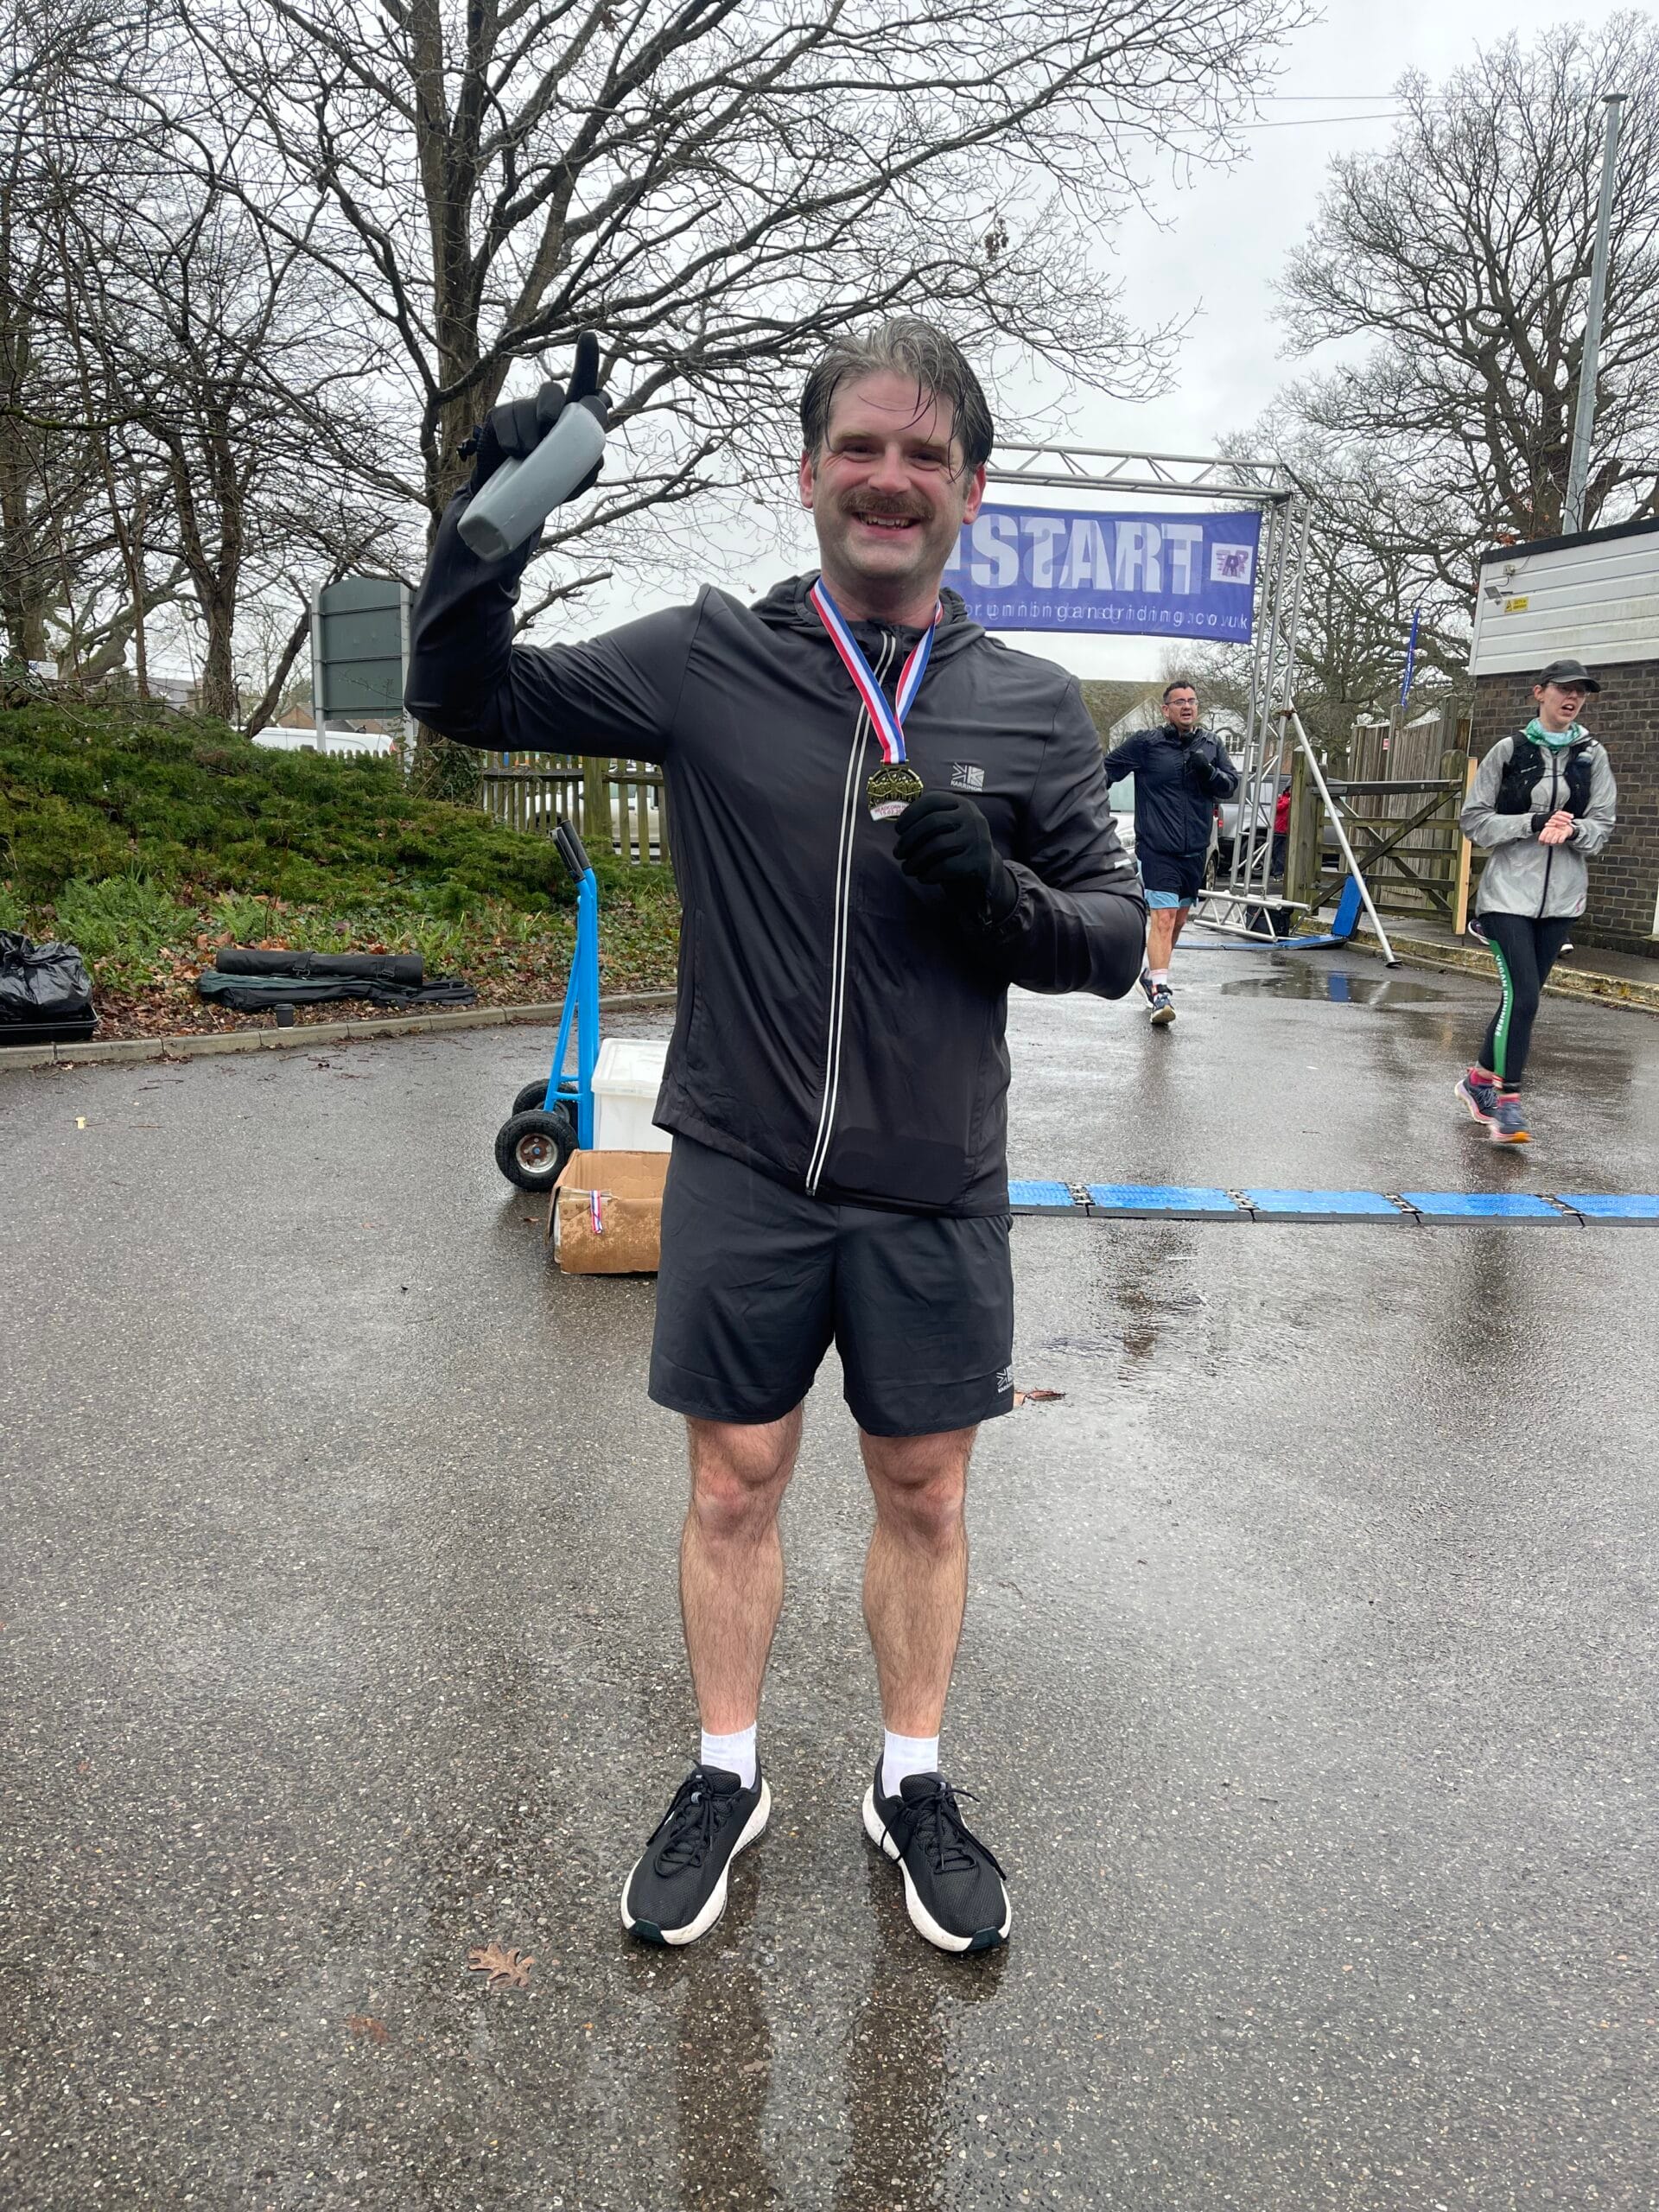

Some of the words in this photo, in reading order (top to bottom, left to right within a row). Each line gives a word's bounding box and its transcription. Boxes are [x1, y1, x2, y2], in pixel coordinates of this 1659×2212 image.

[971, 513, 1203, 594] START
[1496, 954, 1508, 987] VEGAN
[1494, 989, 1509, 1037] RUNNERS
